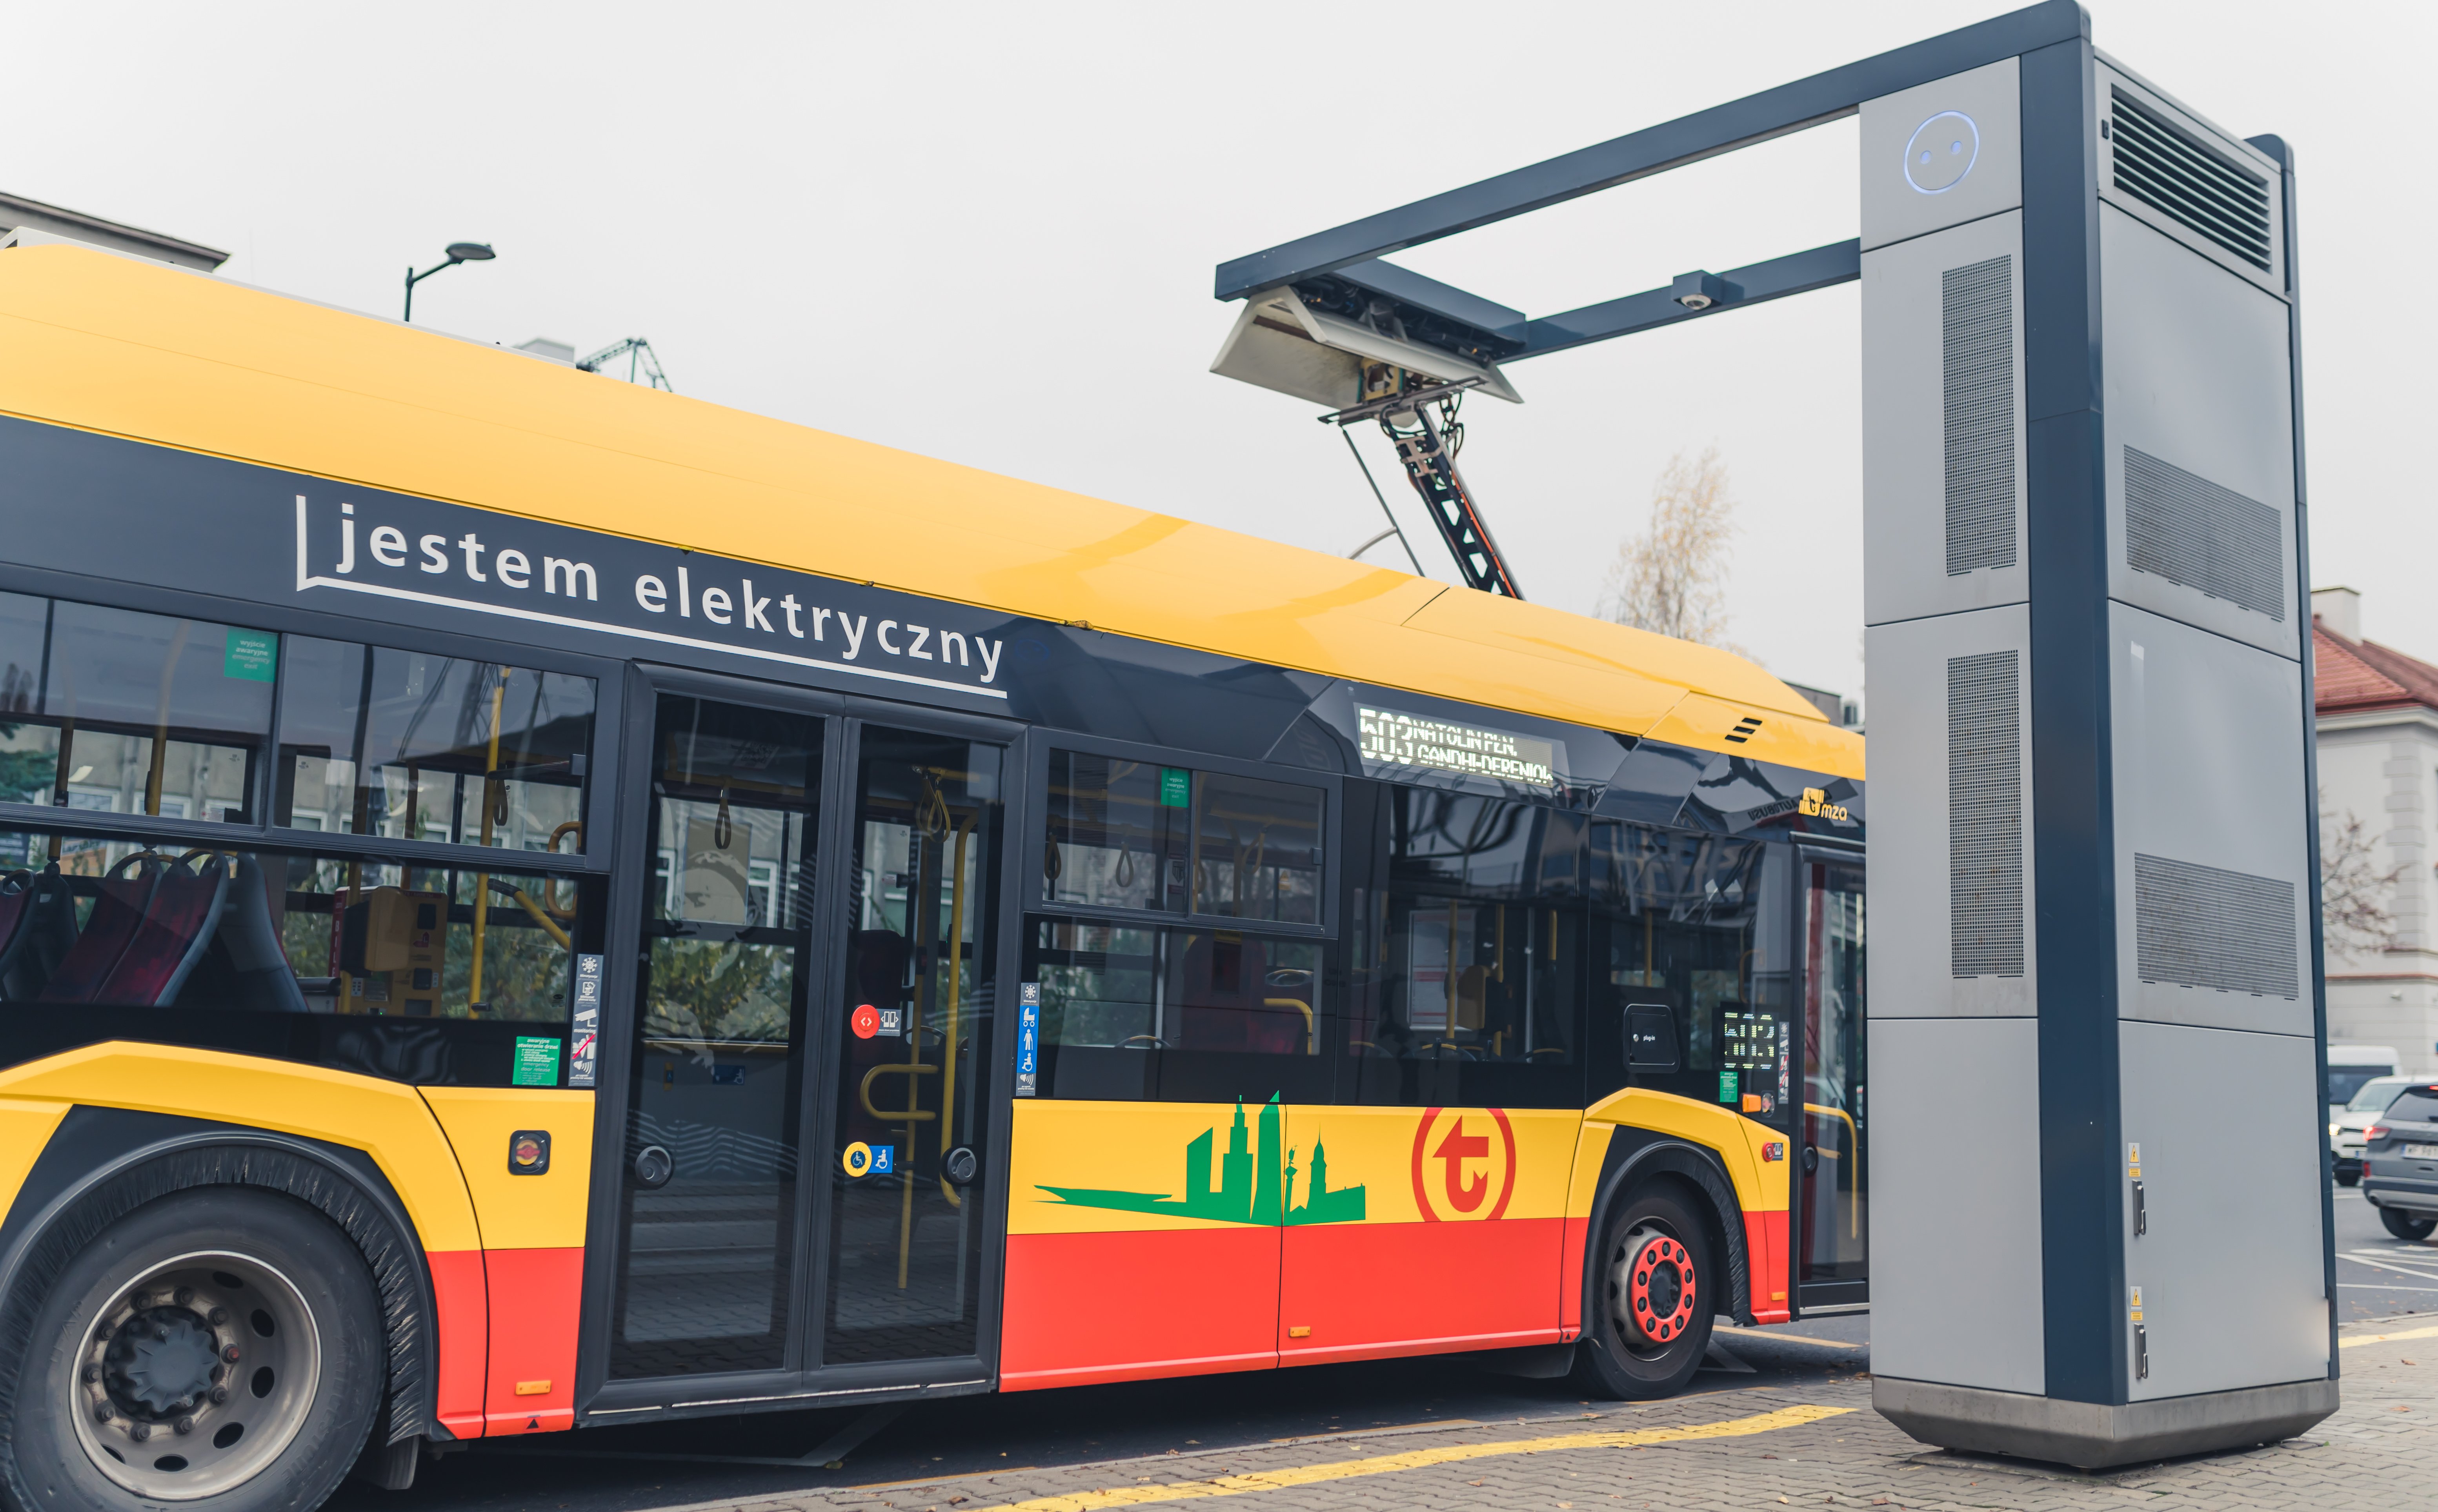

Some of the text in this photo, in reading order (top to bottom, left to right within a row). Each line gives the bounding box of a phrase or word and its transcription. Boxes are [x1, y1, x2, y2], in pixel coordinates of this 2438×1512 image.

[337, 503, 1004, 683] jestem elektryczny
[232, 654, 270, 664] emergency
[236, 648, 268, 656] awaryjne
[1360, 708, 1413, 765] 503
